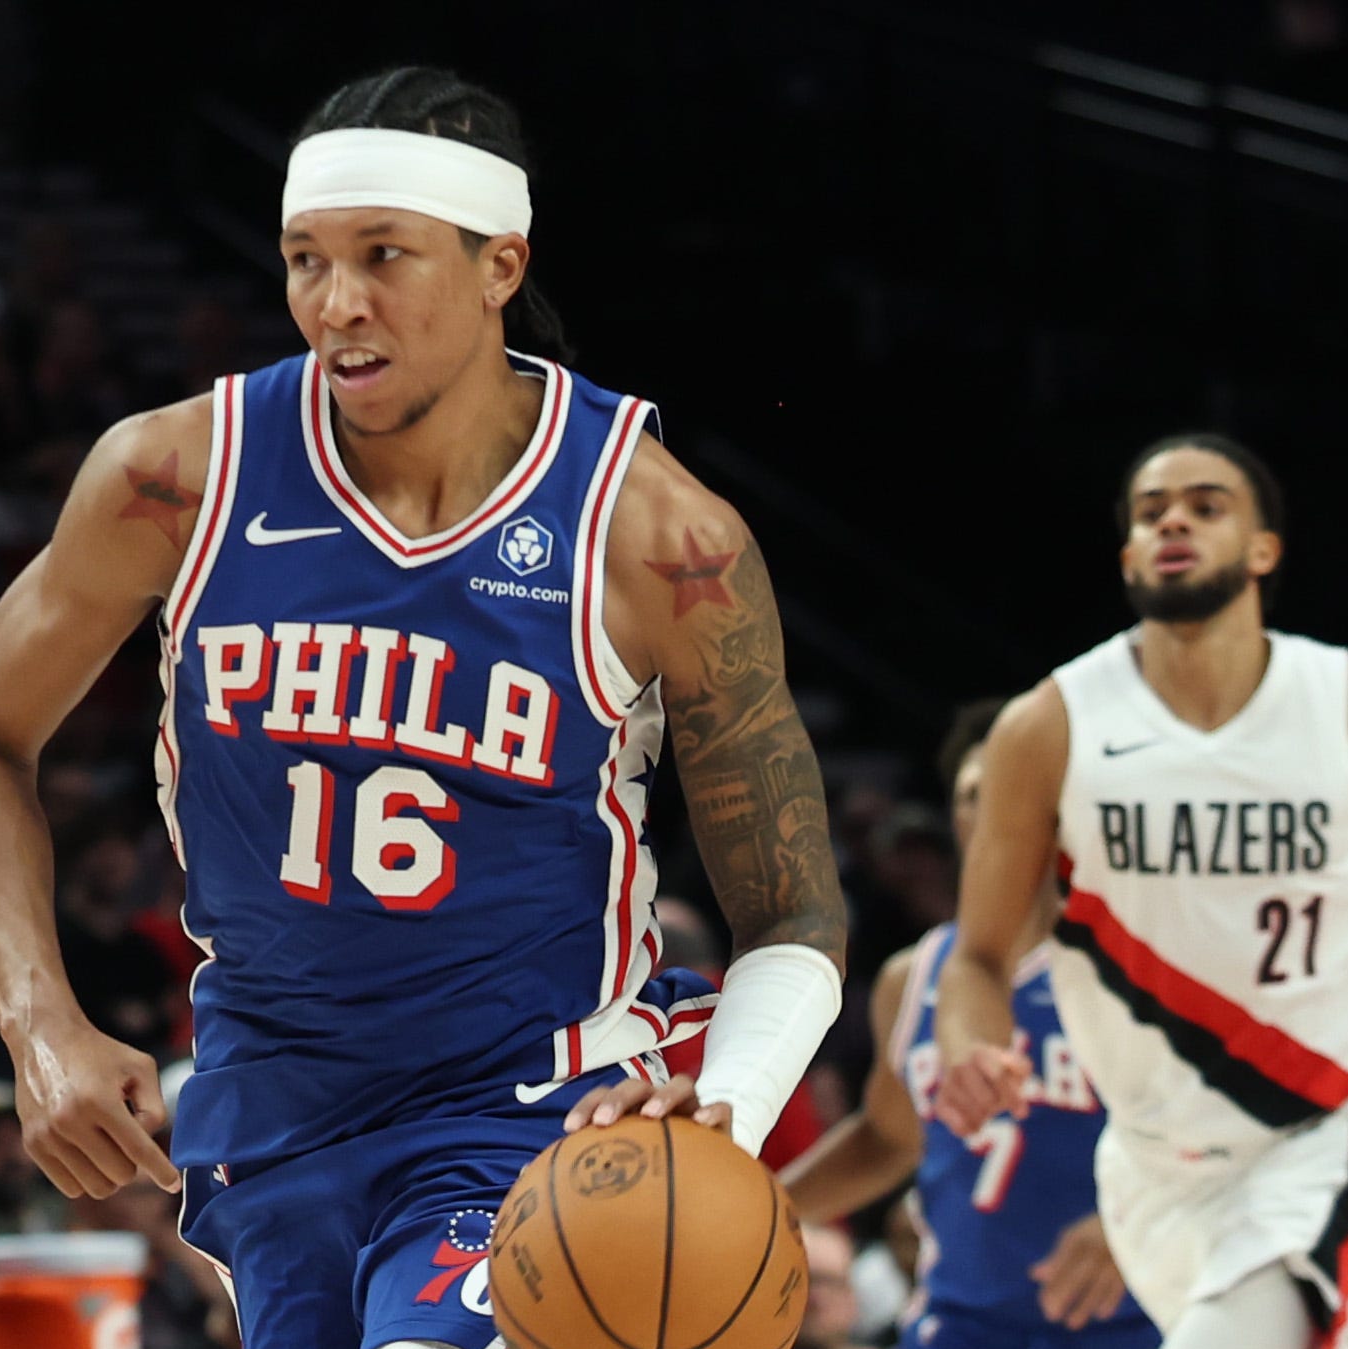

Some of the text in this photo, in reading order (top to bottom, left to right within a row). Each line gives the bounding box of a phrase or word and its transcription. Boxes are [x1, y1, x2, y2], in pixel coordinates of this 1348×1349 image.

[470, 577, 569, 604] crypto.com
[197, 622, 560, 787] PHILA
[280, 760, 460, 911] 16
[1098, 800, 1331, 876] BLAZERS
[1256, 894, 1325, 985] 21
[964, 1115, 1025, 1214] 7
